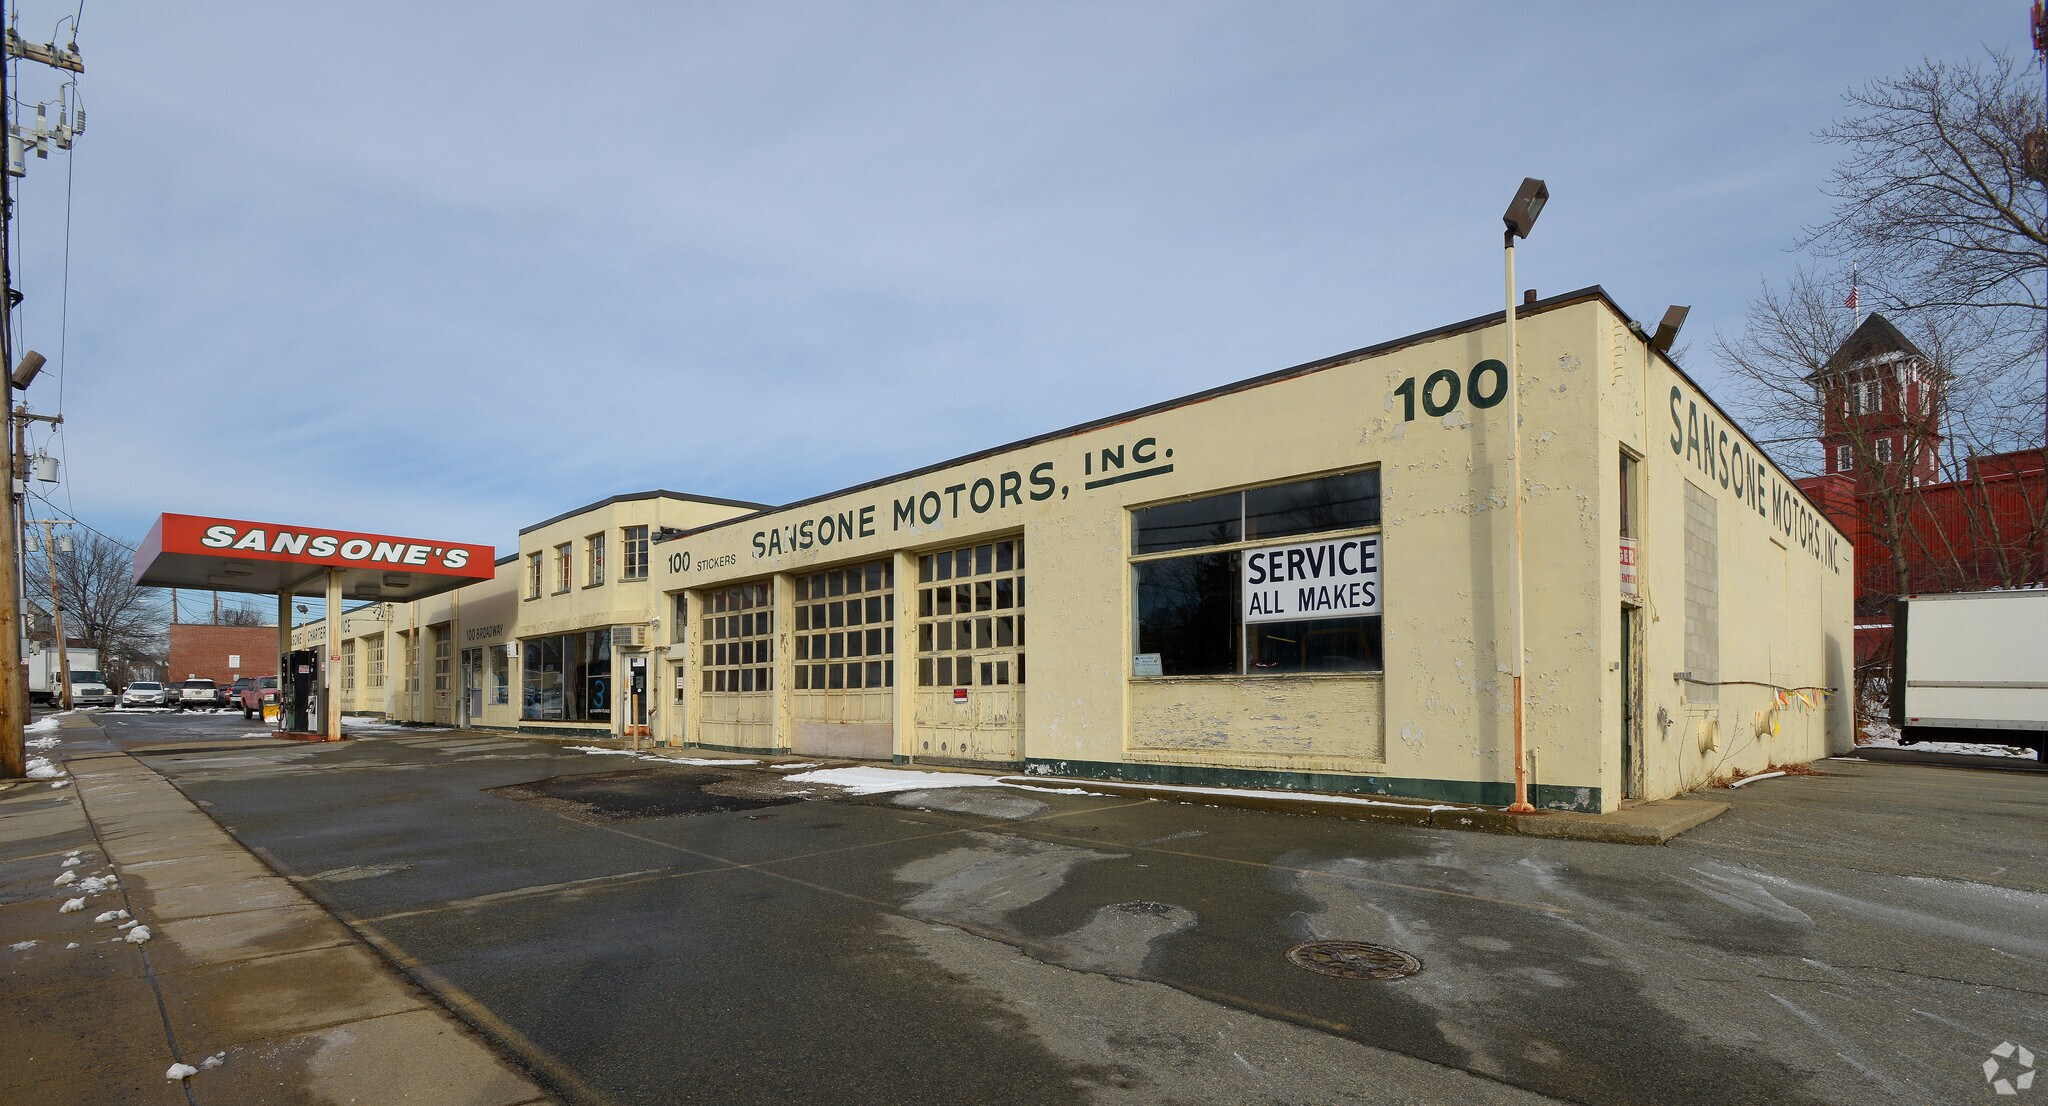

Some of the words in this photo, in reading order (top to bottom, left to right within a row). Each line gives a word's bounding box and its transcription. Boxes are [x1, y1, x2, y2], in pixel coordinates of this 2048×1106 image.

[1393, 358, 1508, 423] 100
[1669, 385, 1766, 518] SANSONE
[752, 504, 876, 559] SANSONE
[893, 462, 1069, 531] MOTORS,
[1084, 437, 1174, 476] INC.
[200, 525, 470, 569] SANSONE'S
[668, 551, 691, 574] 100
[697, 553, 737, 572] STICKERS
[1248, 540, 1378, 585] SERVICE
[1248, 590, 1285, 616] ALL
[1298, 581, 1376, 612] MAKES
[466, 628, 476, 641] 100
[476, 623, 504, 640] BROADWAY
